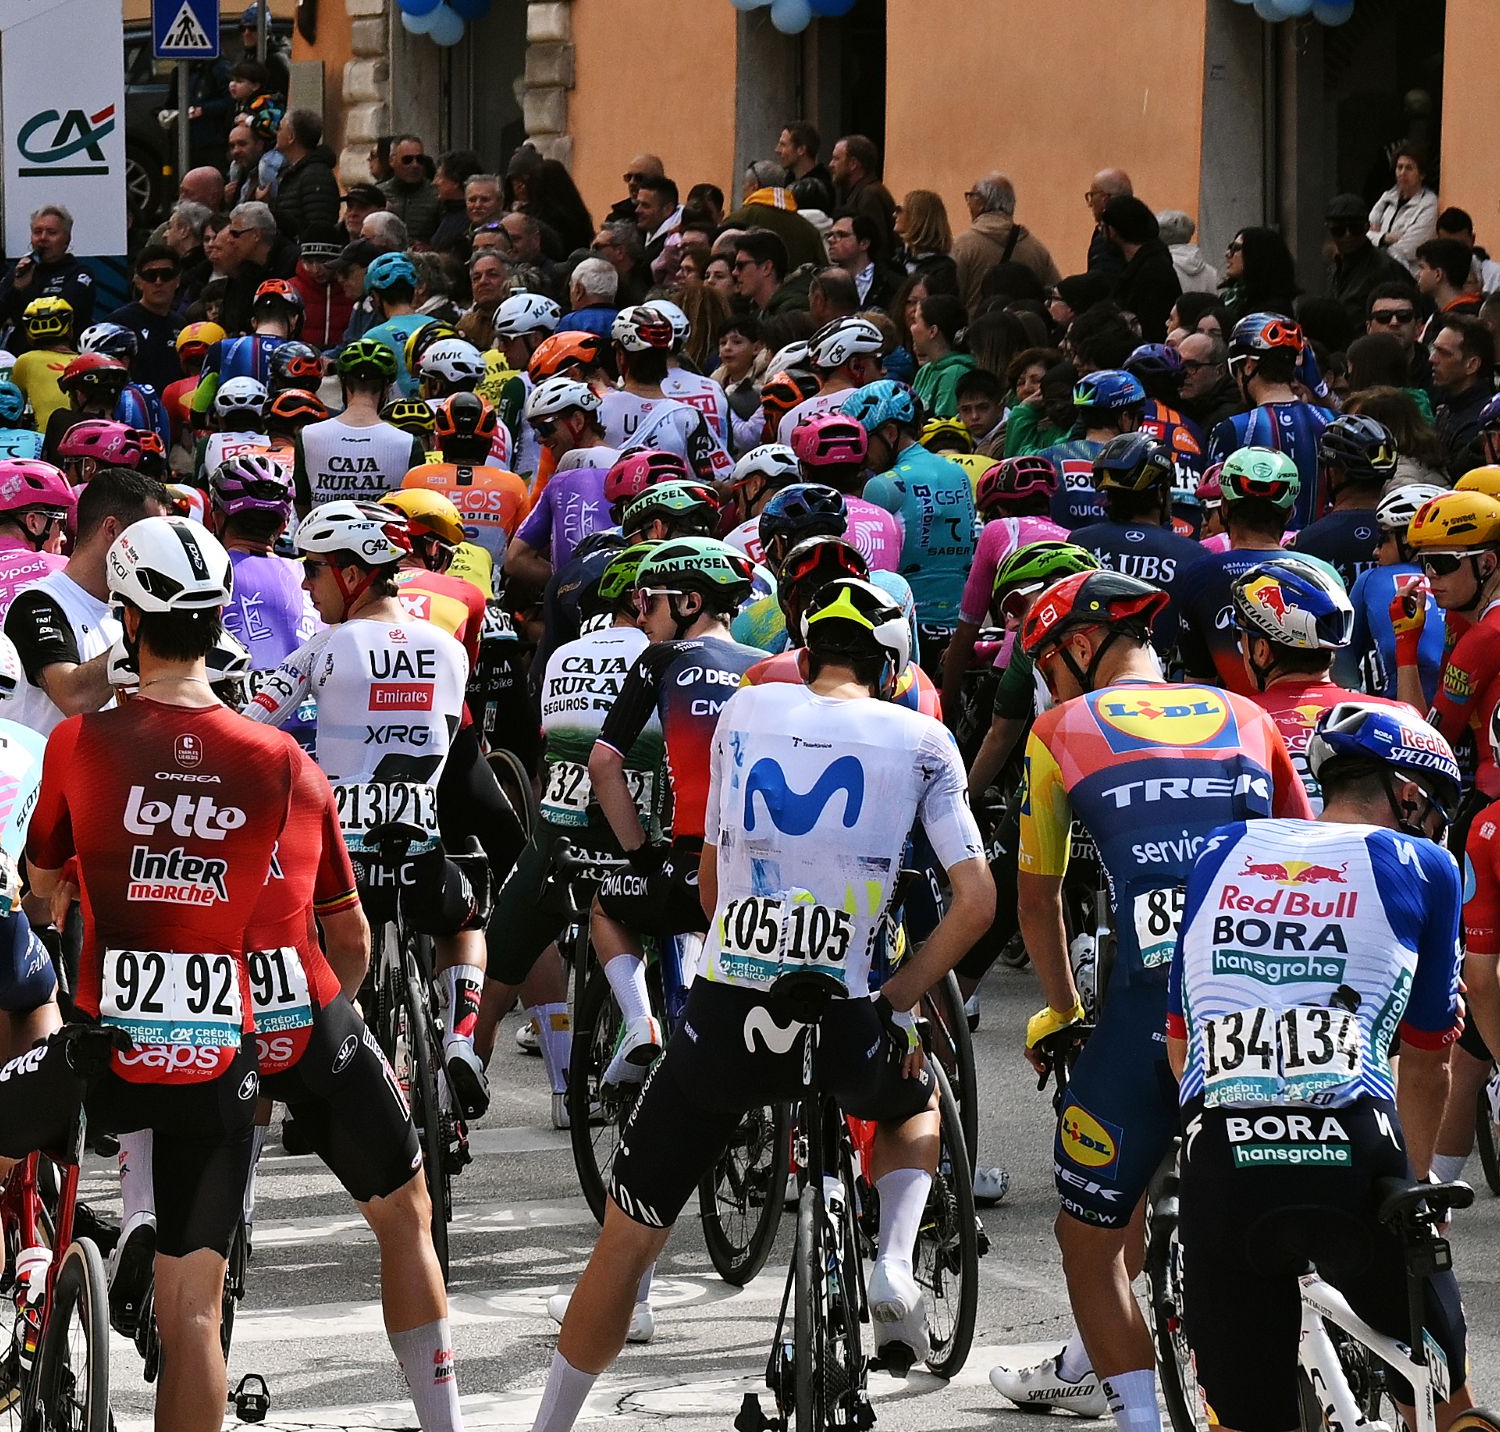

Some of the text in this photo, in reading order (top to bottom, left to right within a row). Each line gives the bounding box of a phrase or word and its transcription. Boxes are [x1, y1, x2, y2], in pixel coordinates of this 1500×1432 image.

[328, 454, 379, 473] CAJA
[316, 472, 391, 491] RURAL
[934, 488, 964, 506] CSF
[913, 484, 931, 548] BARDIANI
[650, 556, 730, 574] VAN RYSEL
[1118, 552, 1177, 582] UBS
[369, 649, 436, 677] UAE
[562, 656, 628, 676] CAJA
[375, 687, 430, 705] Emirates
[364, 724, 429, 746] XRG
[154, 770, 222, 785] ORBEA
[369, 863, 415, 886] IHC
[1219, 883, 1357, 921] Red Bull
[1213, 916, 1347, 954] BORA
[1215, 953, 1341, 982] hansgrohe
[115, 953, 233, 1016] 92 92
[1228, 1117, 1349, 1141] BORA
[1236, 1144, 1348, 1164] hansgrohe
[1027, 1385, 1096, 1402] SPECIALIZED
